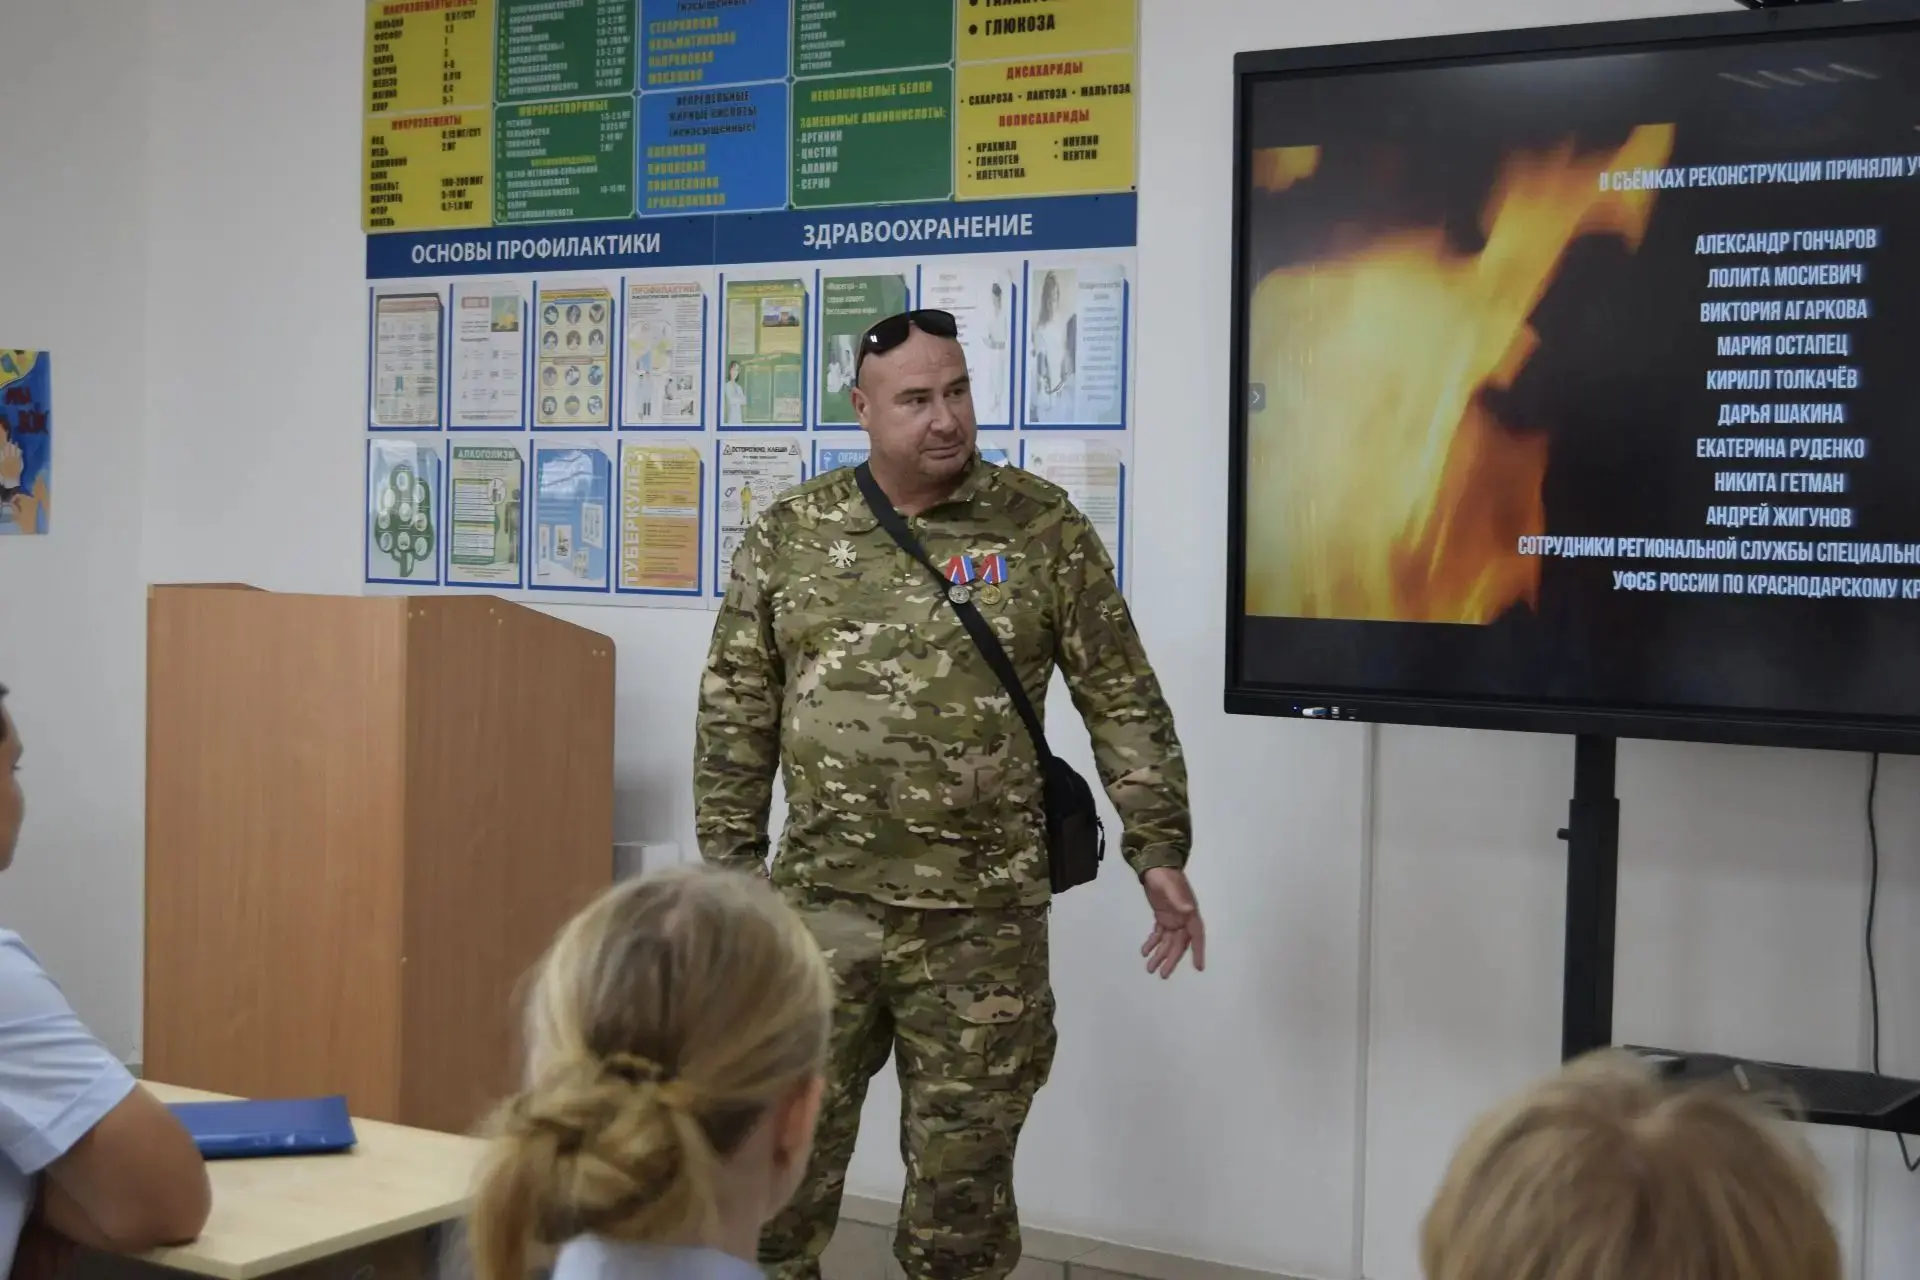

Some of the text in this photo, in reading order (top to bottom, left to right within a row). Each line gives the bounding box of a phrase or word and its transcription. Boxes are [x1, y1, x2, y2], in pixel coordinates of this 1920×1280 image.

[985, 14, 1056, 36] ГЛЮКОЗА
[1006, 61, 1083, 80] ДИСАХАРИДЫ
[676, 91, 749, 106] НЕПРЕДЕЛЬНЫЕ
[899, 80, 933, 95] БЕЛКИ
[968, 83, 1131, 106] САХАРОЗА ЛАКТОЗА МАЛЬТОЗА
[800, 113, 860, 129] ЗАМЕНИМЫЕ
[998, 109, 1090, 128] ПОЛИСАХАРИДЫ
[976, 141, 1017, 153] КРАХМАЛ
[976, 154, 1019, 167] ГЛИКОГЕН
[976, 168, 1026, 180] КЛЕТЧАТКА
[1613, 167, 1686, 191] СЪЁМКАХ
[1689, 161, 1821, 187] РЕКОНСТРУКЦИИ
[1826, 157, 1903, 180] ПРИНЯЛИ
[803, 213, 1033, 250] ЗДРАВООХРАНЕНИЕ
[1695, 229, 1877, 255] АЛЕКСАНДР ГОНЧАРОВ
[411, 232, 661, 264] ОСНОВЫ ПРОФИЛАКТИКИ
[1707, 264, 1862, 288] ЛОЛИТА МОСИЕВИЧ
[1700, 299, 1868, 322] ВИКТОРИЯ АГАРКОВА
[1717, 334, 1849, 357] МАРИЯ ОСТАПЕЦ
[1706, 366, 1857, 391] КИРИЛЛ ТОЛКАЧЁВ
[1717, 403, 1843, 427] ДАРЬЯ ШАКИНА
[458, 450, 516, 460] АЛКОГОЛИЗМ
[1696, 438, 1865, 461] ЕКАТЕРИНА РУДЕНКО
[1714, 472, 1844, 493] НИКИТА ГЕТМАН
[1705, 503, 1852, 528] АНДРЕЙ ЖИГУНОВ
[1517, 536, 1615, 559] СОТРУДНИКИ
[1617, 536, 1737, 560] РЕГИОНАЛЬНОЙ
[1740, 541, 1813, 562] СЛУЖБЫ
[1612, 570, 1656, 592] УФСБ
[1659, 571, 1720, 594] РОССИИ
[1723, 573, 1742, 594] ПО
[1746, 575, 1898, 599] КРАСНОДАРСКОМУ
